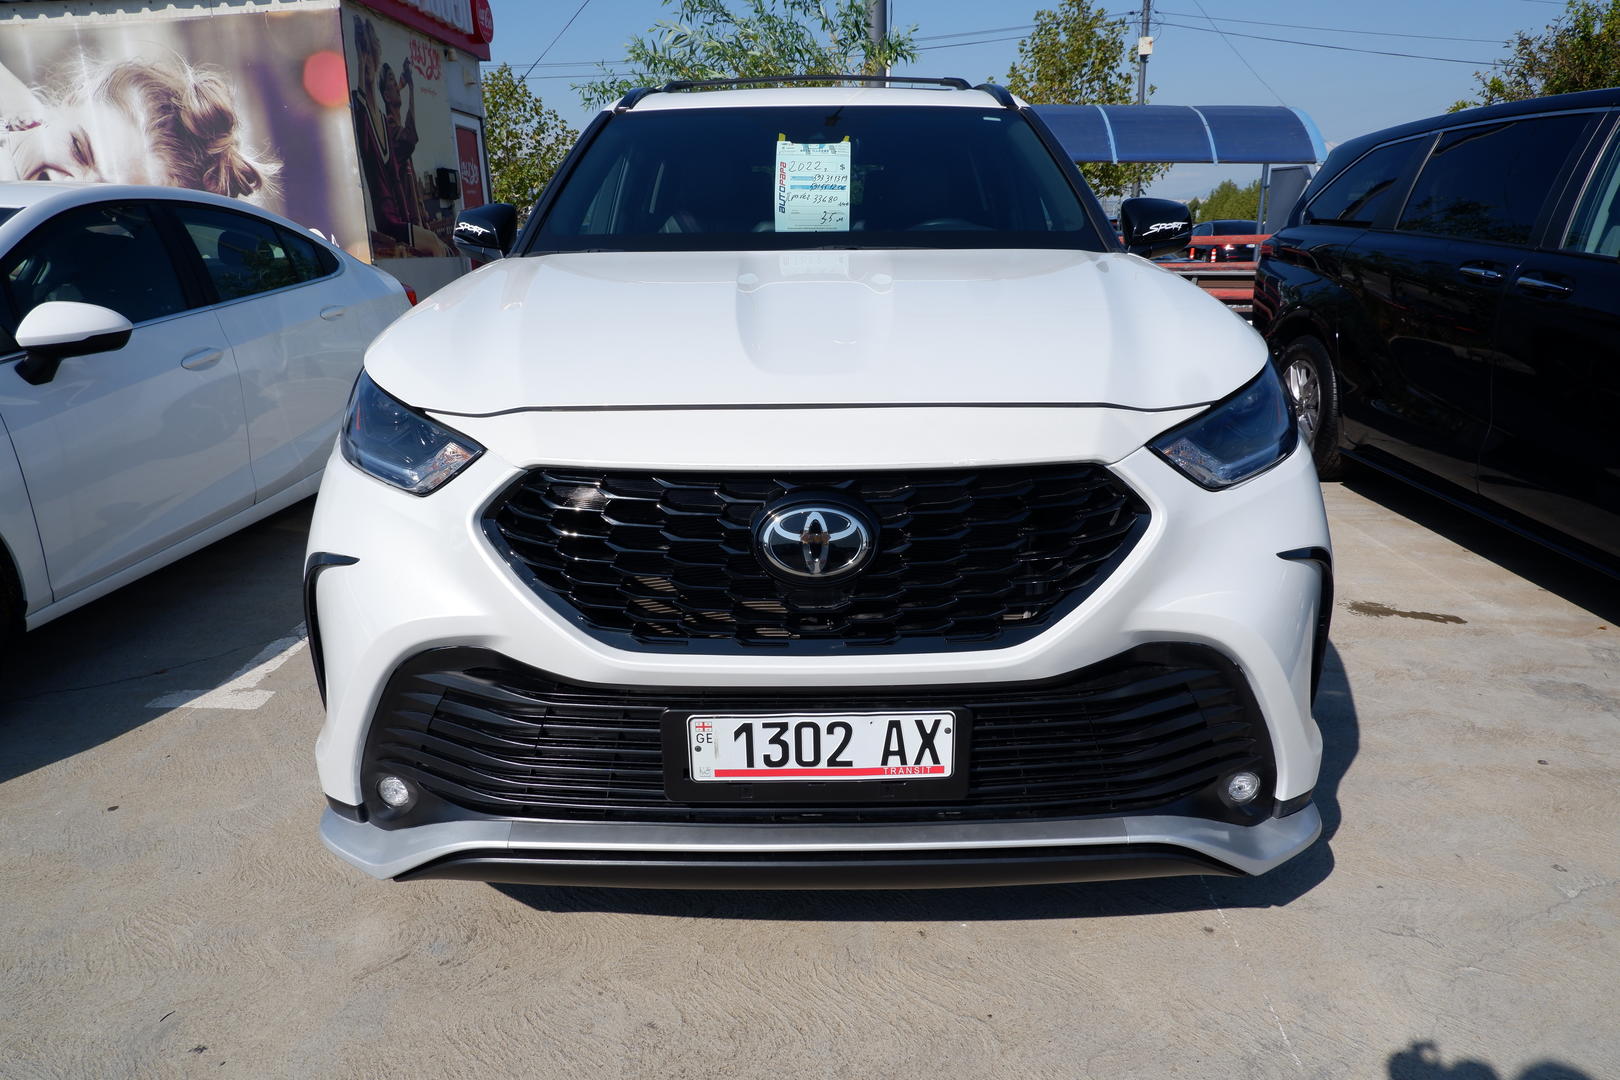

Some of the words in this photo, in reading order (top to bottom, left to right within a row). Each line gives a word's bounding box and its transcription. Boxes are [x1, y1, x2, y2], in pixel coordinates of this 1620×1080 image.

[455, 222, 490, 236] SPORT
[1142, 221, 1188, 236] SPORT
[696, 733, 713, 744] GE
[733, 721, 853, 768] 1302
[880, 719, 942, 766] AX
[883, 766, 932, 775] TRANSIT
